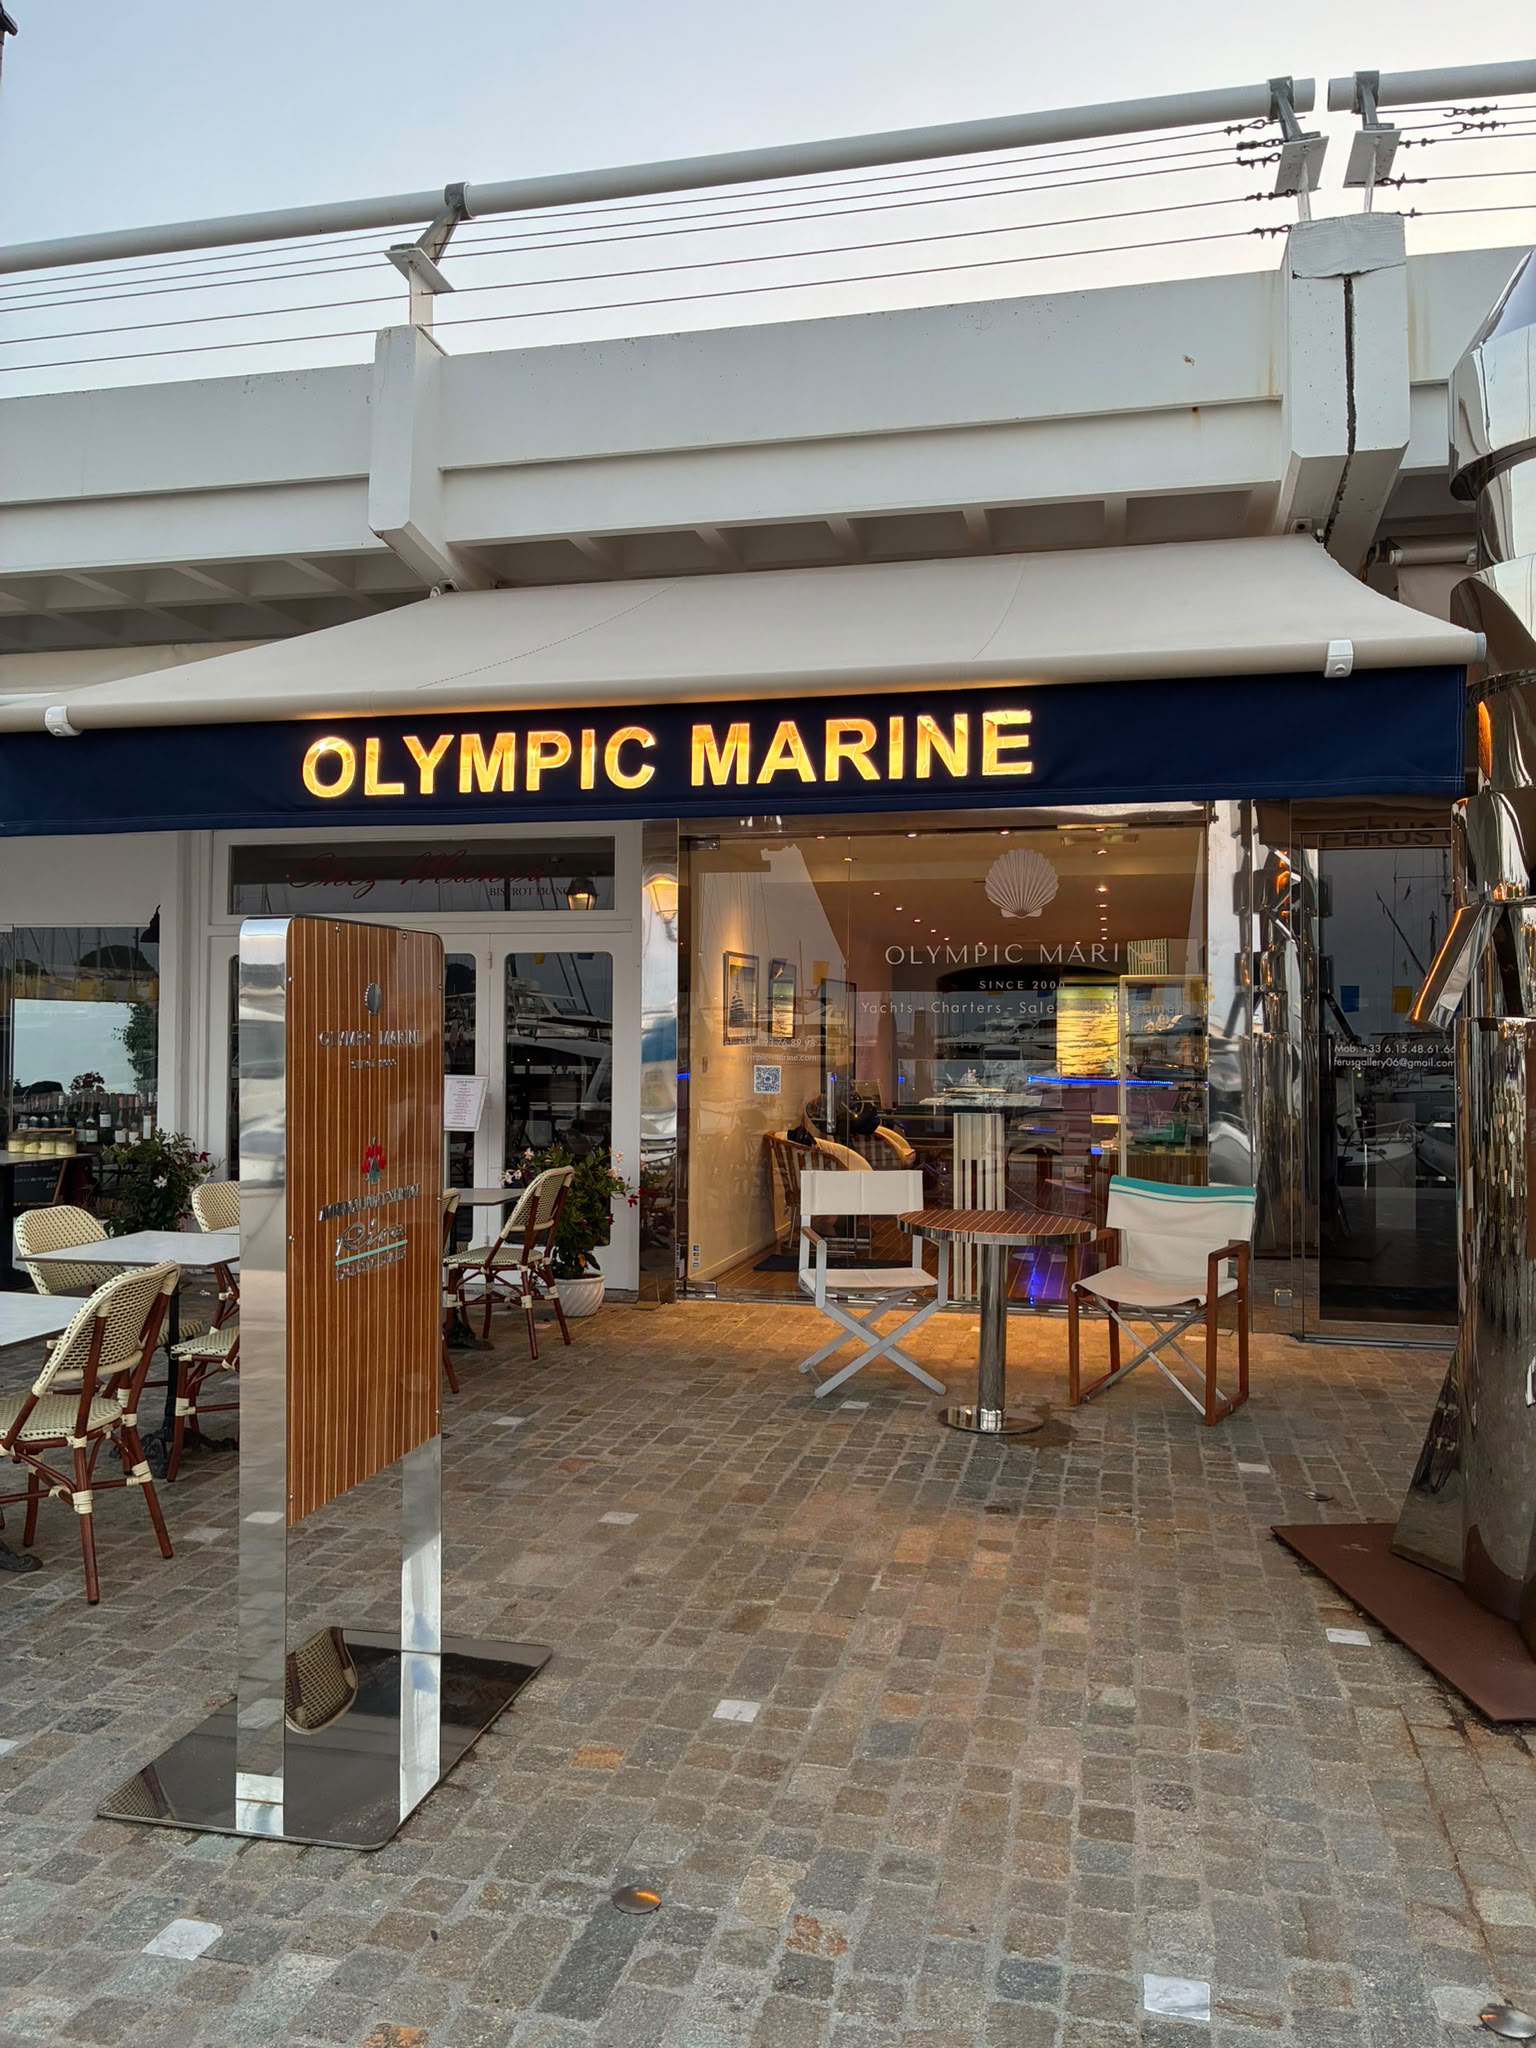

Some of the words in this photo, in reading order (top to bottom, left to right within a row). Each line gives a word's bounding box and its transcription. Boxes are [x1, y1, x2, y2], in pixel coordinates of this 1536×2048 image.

[303, 727, 655, 798] OLYMPIC
[691, 710, 1032, 786] MARINE
[489, 887, 534, 896] BISROT
[885, 943, 1024, 965] OLYMPIC
[979, 980, 1025, 990] SINCE
[1032, 980, 1065, 990] 2000
[861, 1001, 914, 1014] Yachts
[931, 1000, 1002, 1014] Charters
[1019, 1000, 1056, 1014] Sale
[1362, 1044, 1381, 1053] +33
